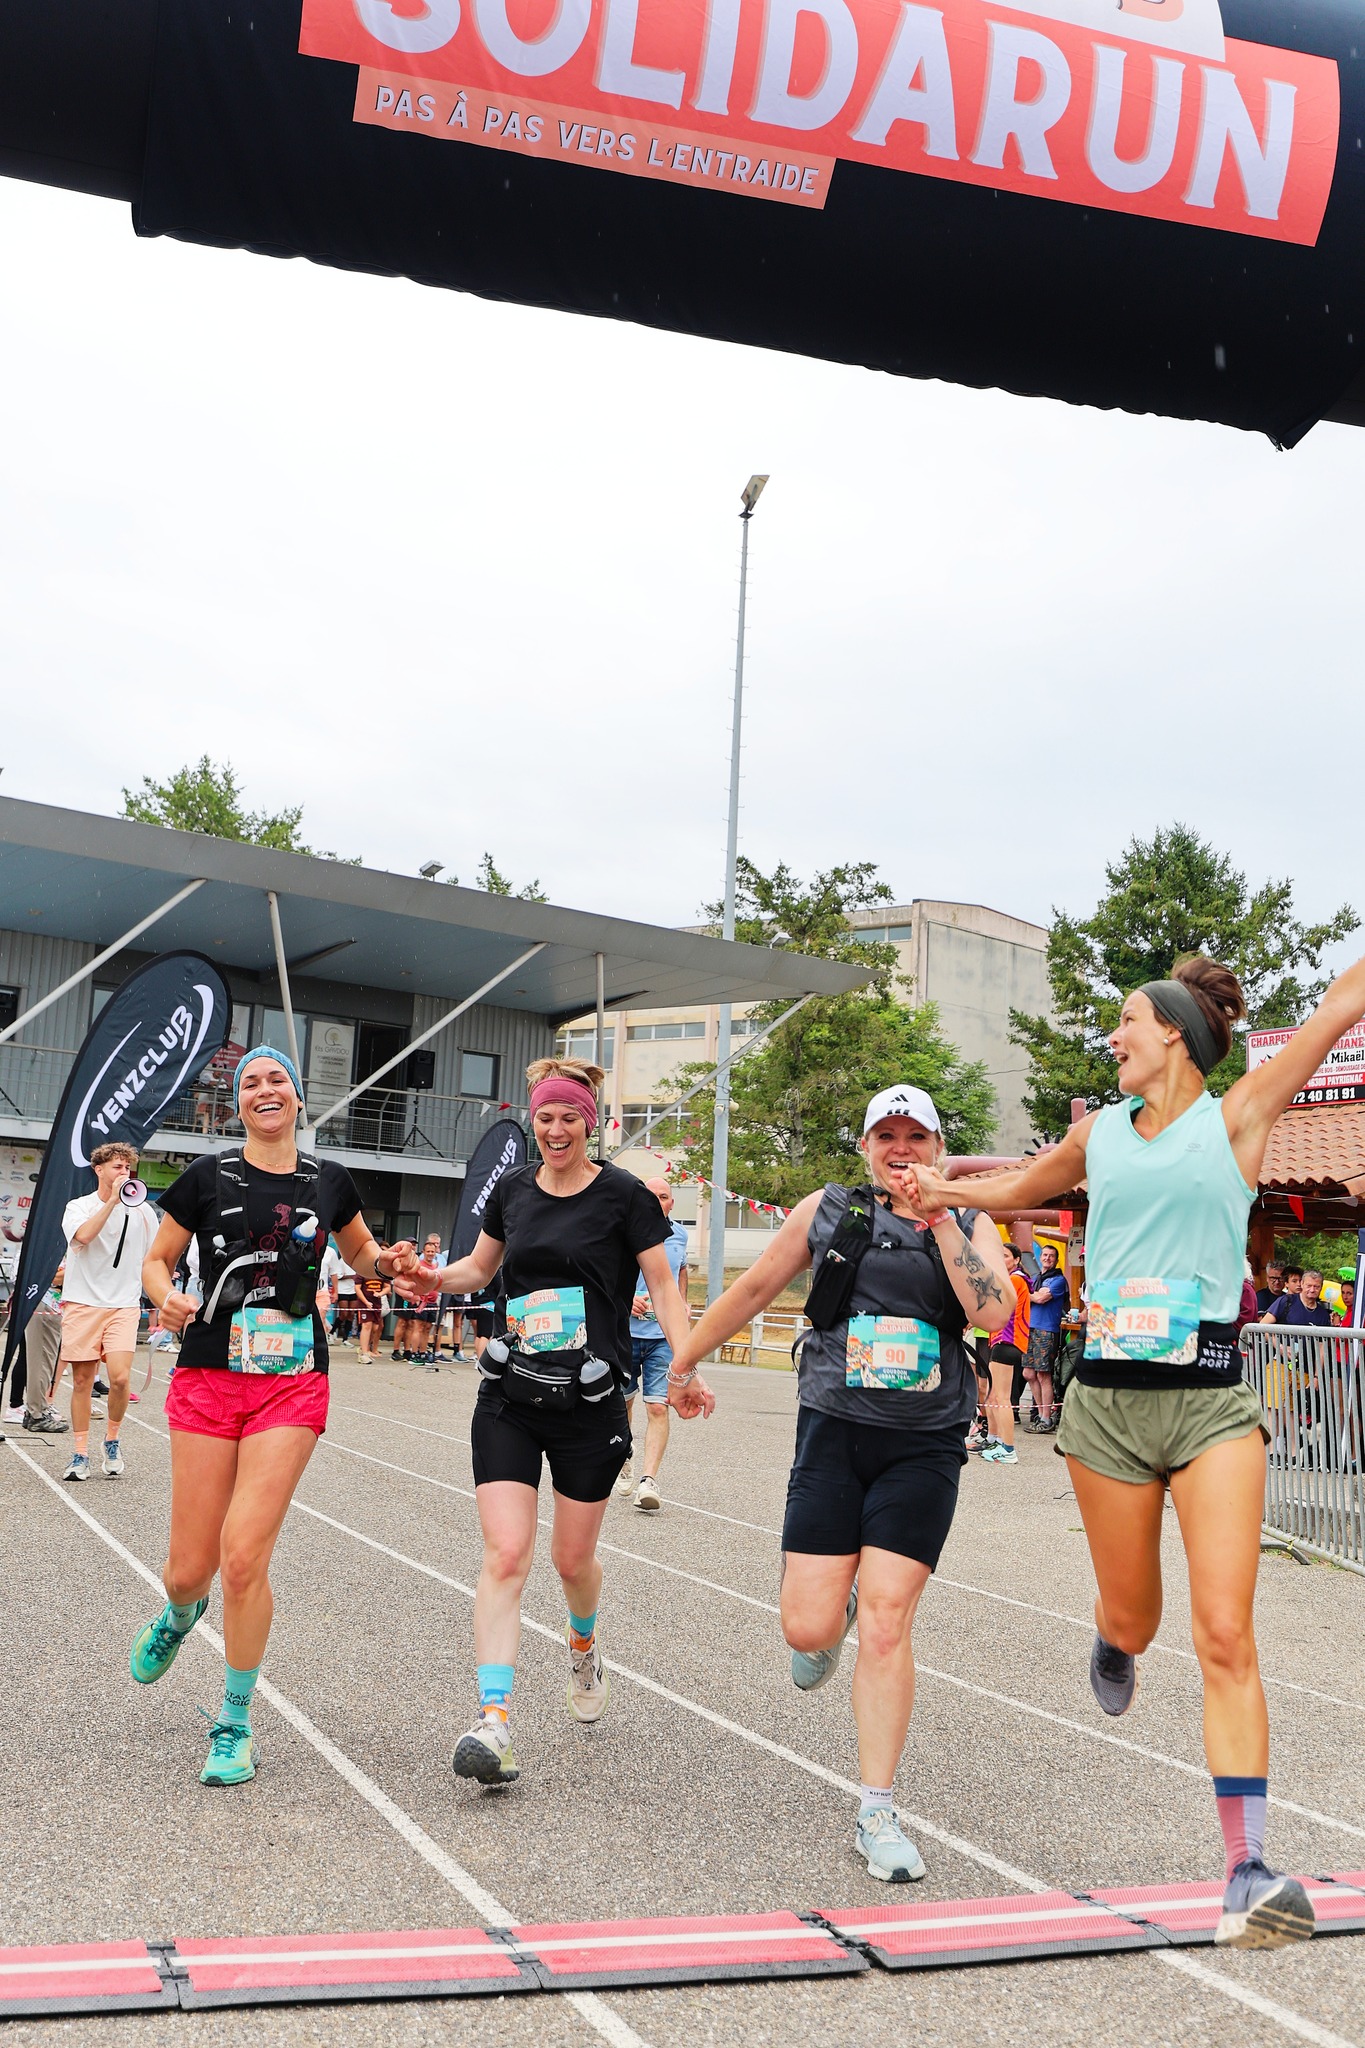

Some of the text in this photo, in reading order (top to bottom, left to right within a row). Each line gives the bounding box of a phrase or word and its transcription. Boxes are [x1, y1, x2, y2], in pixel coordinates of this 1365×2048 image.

[374, 85, 821, 196] PAS À PAS VERS L'ENTRAIDE
[1251, 1033, 1296, 1048] CHARPEN
[1333, 1037, 1364, 1051] RIANE
[1331, 1050, 1364, 1064] Mikaël
[1307, 1073, 1364, 1088] 46300 PAYRIGNAC
[1307, 1089, 1323, 1102] 40
[1325, 1088, 1339, 1101] 81
[1341, 1087, 1356, 1099] 91
[1120, 1286, 1167, 1296] SOLIDARUN
[533, 1316, 551, 1331] 75
[876, 1325, 917, 1333] SOLIDARUN
[1125, 1313, 1159, 1331] 126
[264, 1336, 283, 1352] 72
[885, 1347, 906, 1364] 90
[1203, 1348, 1230, 1359] RESS
[1198, 1357, 1230, 1369] PORT
